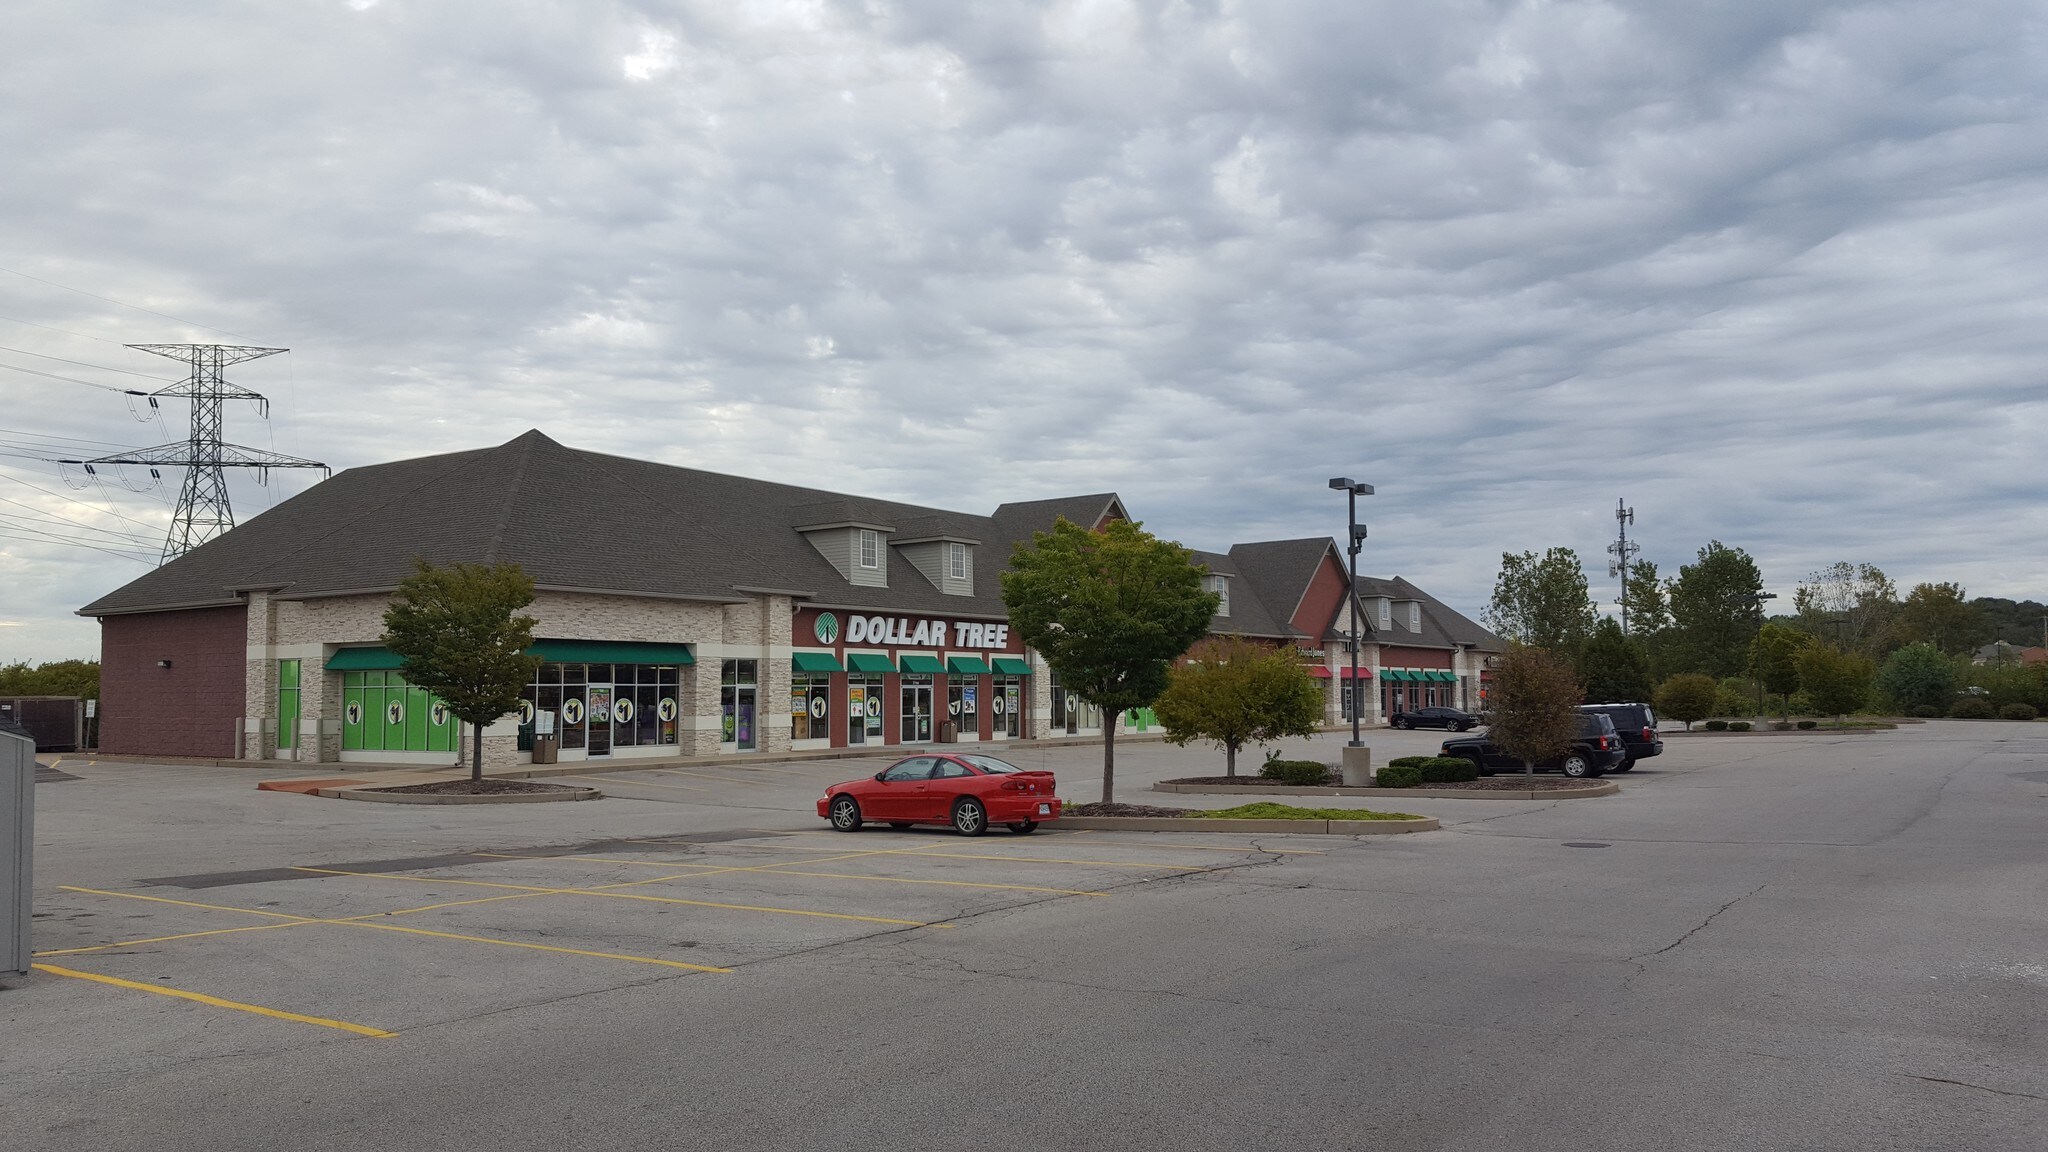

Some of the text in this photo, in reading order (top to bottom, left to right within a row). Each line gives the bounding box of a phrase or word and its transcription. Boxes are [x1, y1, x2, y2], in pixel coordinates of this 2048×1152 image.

[845, 615, 1009, 648] DOLLAR TREE
[567, 703, 579, 723] $1
[617, 703, 629, 721] $1
[662, 702, 673, 720] $1
[814, 701, 822, 717] $1
[869, 701, 877, 716] $1
[995, 700, 1002, 713] $1
